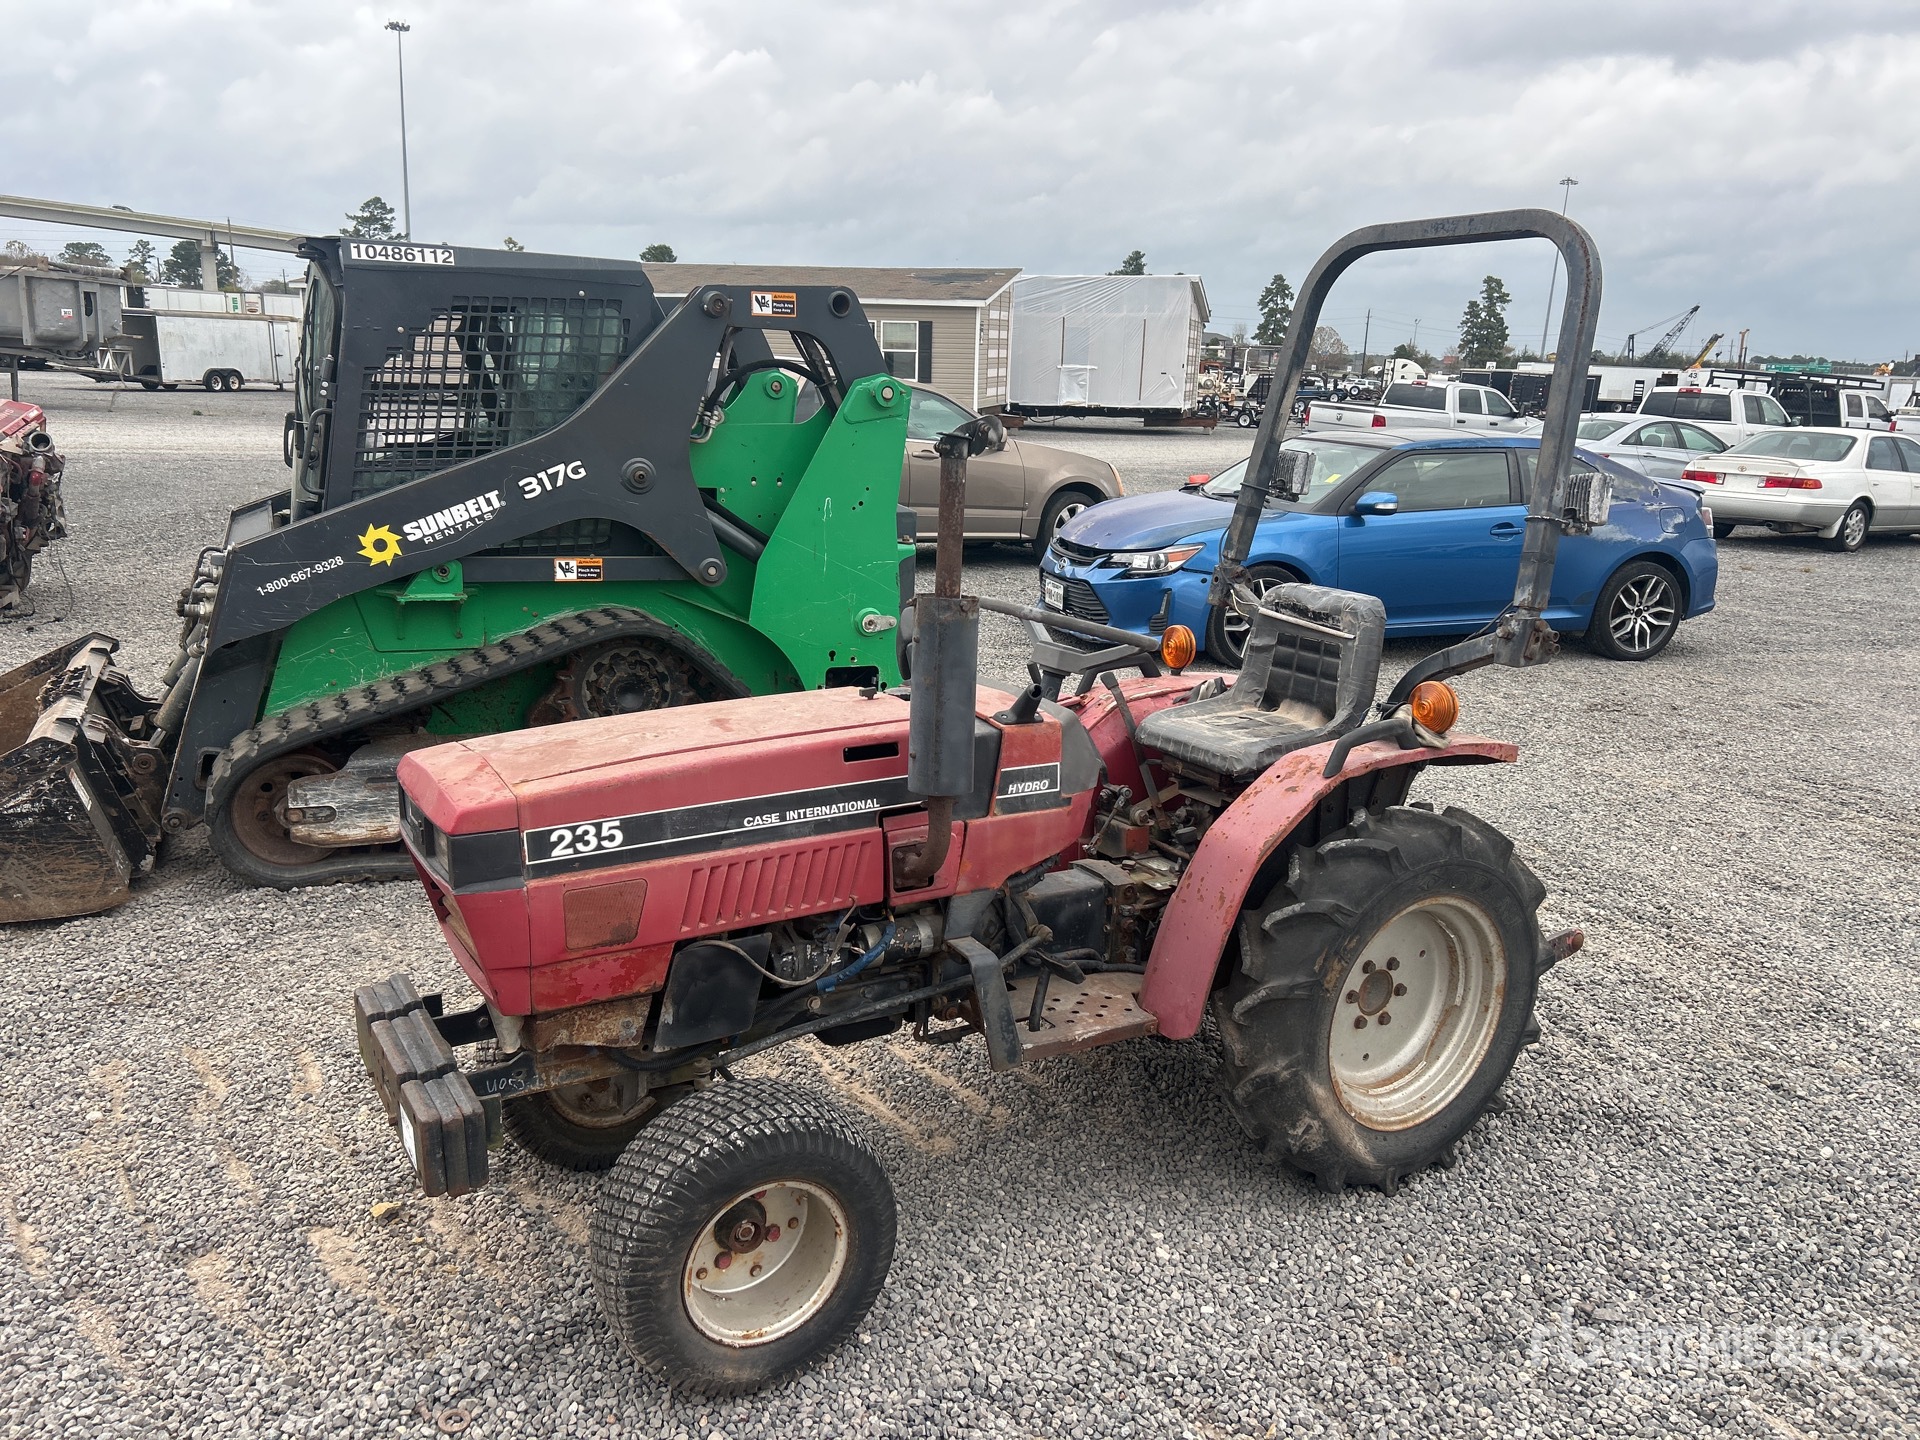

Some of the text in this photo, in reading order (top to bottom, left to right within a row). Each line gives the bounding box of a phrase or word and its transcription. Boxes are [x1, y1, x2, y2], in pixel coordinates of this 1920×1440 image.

[353, 244, 453, 264] 10486112
[518, 461, 587, 500] 317G
[402, 489, 500, 542] SUNBELT
[424, 513, 494, 545] RENTALS
[256, 555, 344, 596] 1-800-667-9328
[1008, 779, 1049, 794] HYDRO
[743, 798, 880, 827] CASE INTERNATIONAL
[549, 820, 624, 857] 235
